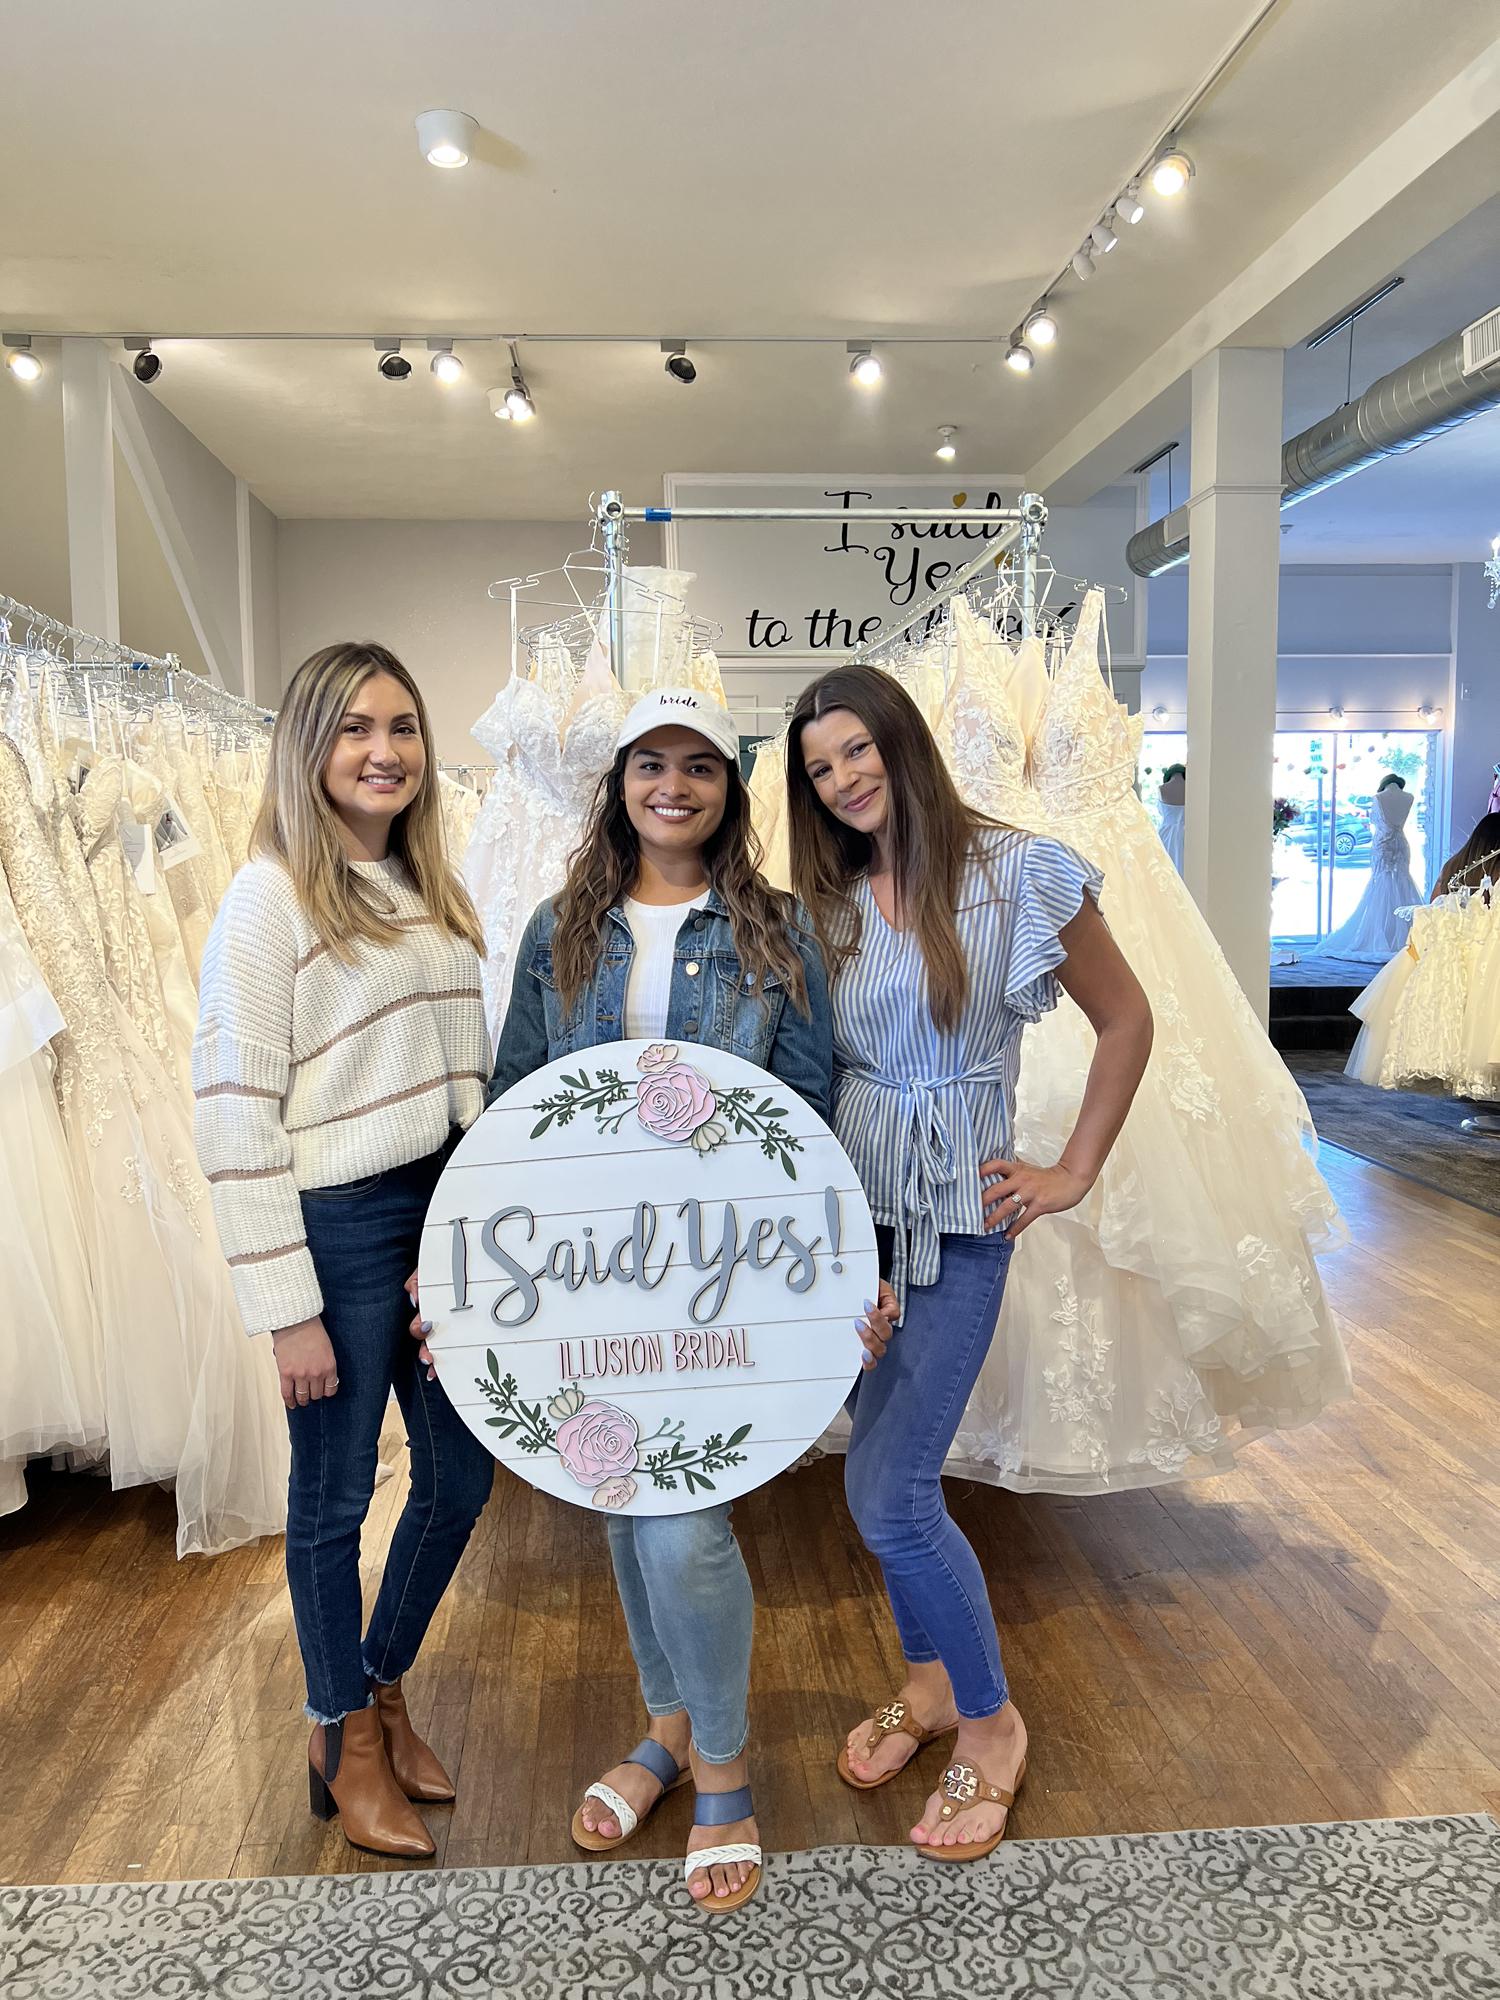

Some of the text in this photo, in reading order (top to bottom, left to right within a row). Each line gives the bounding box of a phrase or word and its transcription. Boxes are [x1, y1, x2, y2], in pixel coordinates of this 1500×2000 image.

[824, 490, 872, 552] I
[874, 547, 982, 606] Ye
[745, 609, 793, 649] to
[804, 608, 882, 649] the
[659, 695, 701, 709] bride
[448, 1185, 844, 1327] I Said Yes!
[558, 1327, 756, 1381] ILLUSION BRIDAL
